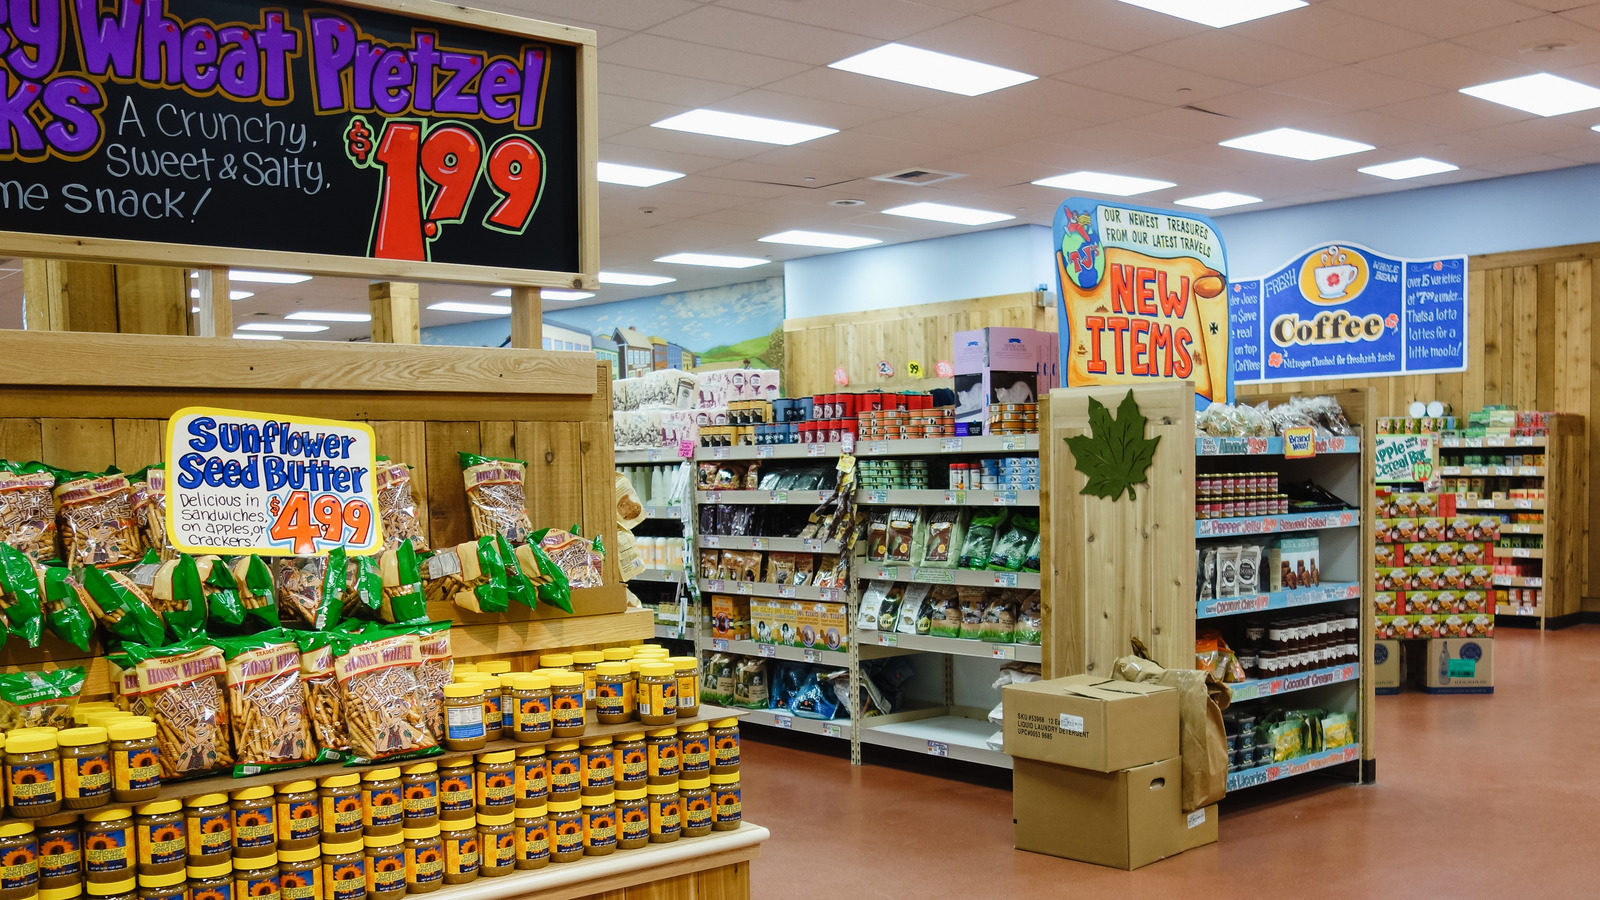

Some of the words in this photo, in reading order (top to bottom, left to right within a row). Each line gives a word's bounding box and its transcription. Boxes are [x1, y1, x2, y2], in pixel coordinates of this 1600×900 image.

[77, 0, 297, 99] Wheat
[310, 17, 545, 128] Pretzel
[119, 95, 146, 138] A
[156, 103, 318, 154] Crunchy,
[106, 143, 216, 182] Sweet
[218, 153, 238, 180] &
[243, 151, 331, 195] Salty,
[1104, 208, 1121, 223] OUR
[1128, 212, 1159, 229] NEWEST
[1167, 217, 1209, 240] TREASURES
[1106, 228, 1129, 242] FROM
[1132, 230, 1148, 245] OUR
[1152, 234, 1178, 249] LATEST
[1180, 237, 1211, 258] TRAVELS
[1372, 260, 1400, 274] WHOLE
[1265, 268, 1297, 298] FRESH
[1375, 271, 1399, 283] BEAN
[1430, 272, 1462, 286] varieties
[1110, 263, 1190, 319] NEW
[1407, 293, 1416, 306] at
[1435, 307, 1457, 321] lotta
[1236, 326, 1253, 339] real
[1272, 312, 1382, 345] Coffee
[1408, 327, 1435, 341] lattes
[1436, 326, 1447, 339] for
[1449, 328, 1456, 338] a
[1085, 315, 1194, 379] ITEMS
[1244, 343, 1258, 356] top
[1408, 345, 1430, 359] little
[1430, 341, 1462, 358] moola!
[1377, 351, 1396, 363] taste
[187, 416, 357, 460] Sunflower
[1288, 433, 1311, 444] Brand
[177, 452, 261, 490] Seed
[263, 455, 369, 494] Butter
[180, 493, 242, 508] Delicious
[247, 493, 260, 508] in
[181, 523, 201, 532] on
[1211, 519, 1241, 535] Pepper
[1279, 517, 1308, 531] Seaweed
[1307, 515, 1327, 529] Salad
[146, 664, 180, 686] HONEY
[181, 655, 222, 679] WHEAT
[1017, 712, 1027, 720] SKU
[1017, 720, 1033, 729] LIQUID
[1034, 723, 1058, 733] LAUNDRY
[15, 782, 54, 792] sunflower
[31, 785, 54, 795] butter
[3, 871, 21, 879] seed
